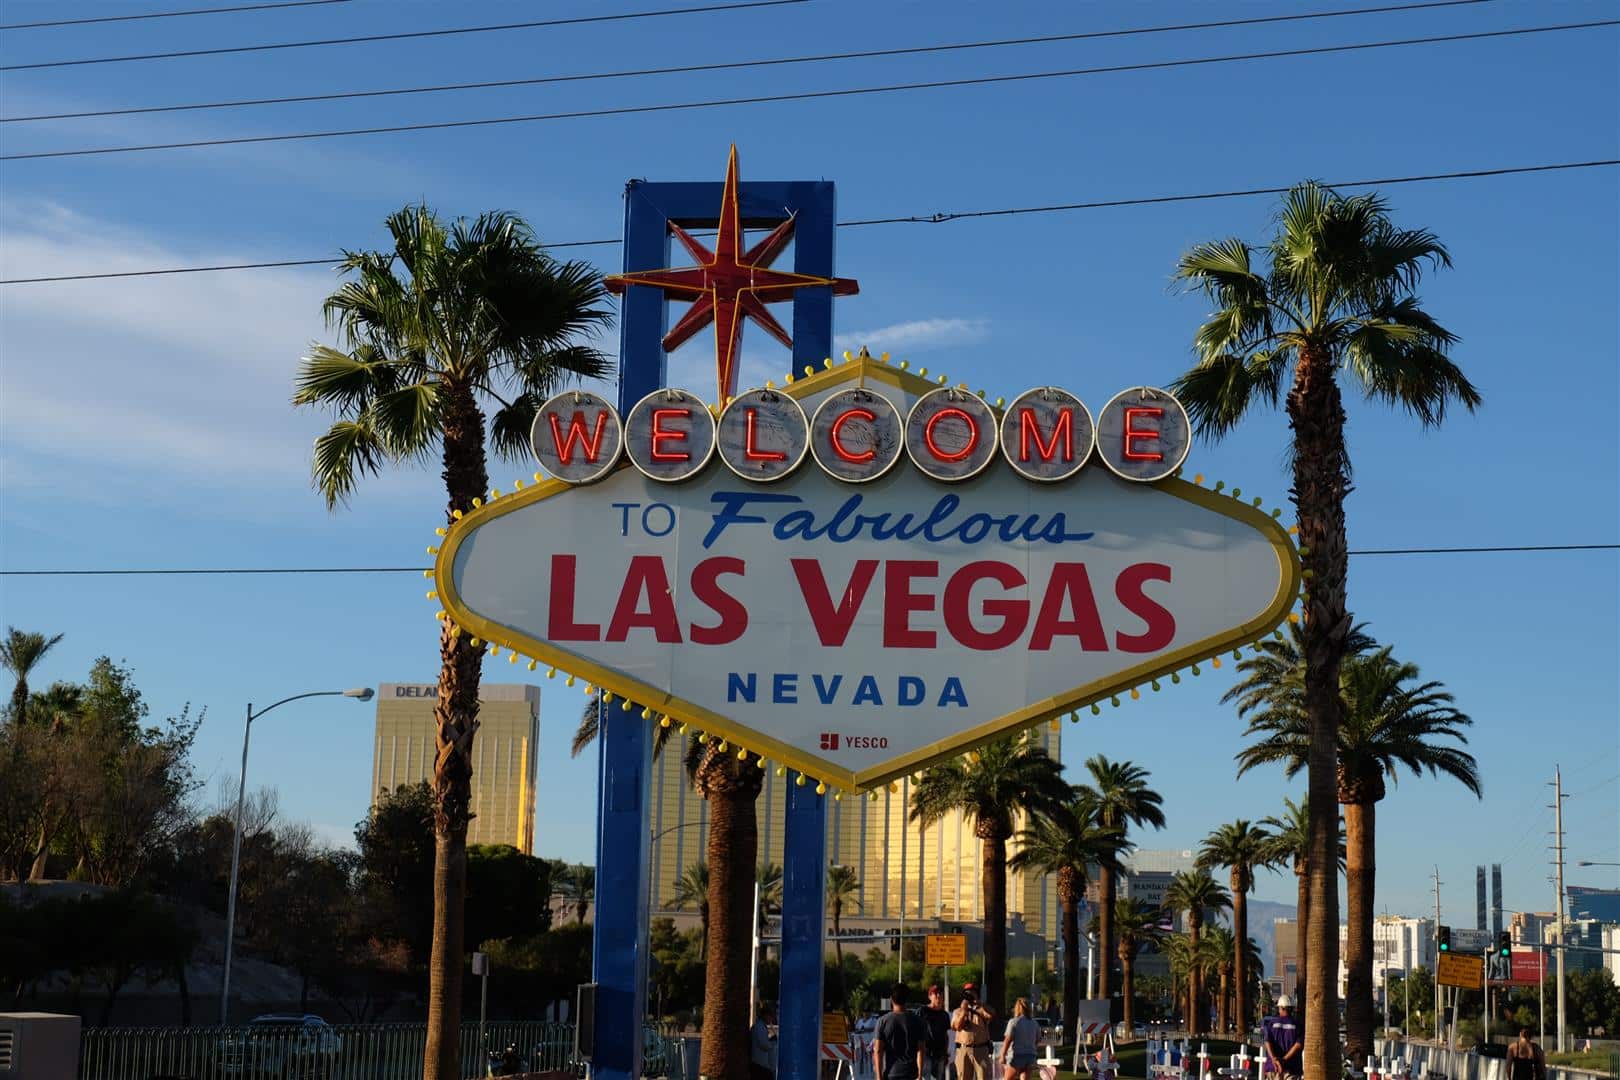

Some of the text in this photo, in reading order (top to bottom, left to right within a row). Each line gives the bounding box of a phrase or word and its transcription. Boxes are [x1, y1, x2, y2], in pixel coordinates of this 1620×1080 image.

[549, 404, 1166, 464] WELCOME
[612, 491, 1096, 549] TO Fabulous
[546, 553, 1177, 653] LAS VEGAS
[396, 686, 437, 697] DELA
[727, 672, 969, 707] NEVADA
[845, 736, 889, 749] YESCO
